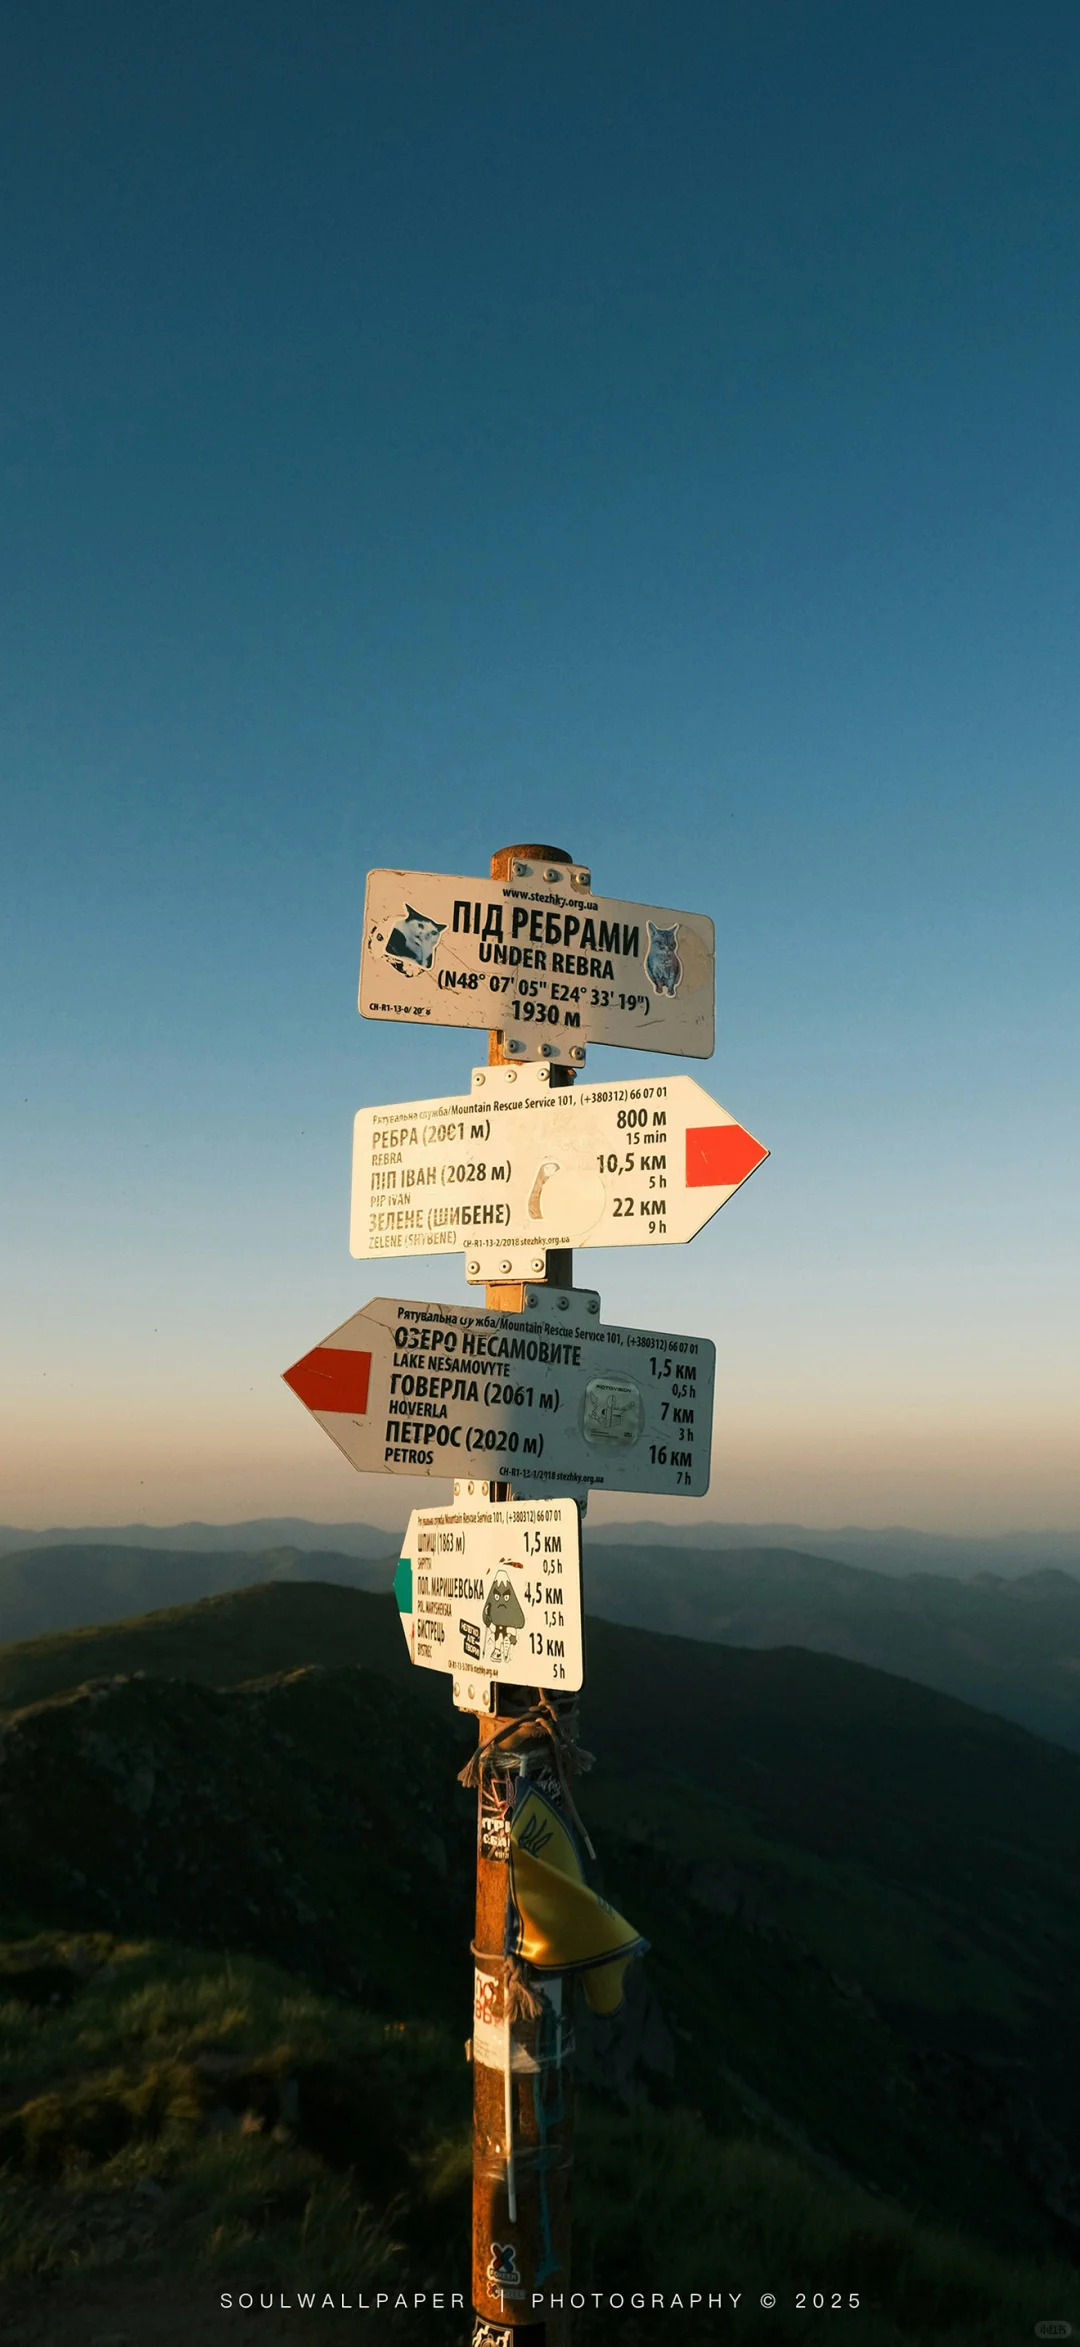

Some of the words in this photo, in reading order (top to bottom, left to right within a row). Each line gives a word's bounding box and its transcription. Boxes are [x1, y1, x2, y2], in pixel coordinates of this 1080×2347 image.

[502, 887, 598, 911] www.stezhky.org.ua
[452, 900, 504, 943] ПІД
[512, 907, 640, 958] РЕБРАМИ
[479, 942, 548, 971] UNDER
[551, 951, 615, 980] REBRA
[437, 969, 486, 991] (N48°
[551, 984, 587, 1004] E24°
[511, 1000, 560, 1026] 1930
[493, 1099, 523, 1112] Rescue
[525, 1096, 556, 1109] Service
[558, 1094, 577, 1107] 101,
[580, 1089, 628, 1106] (+380312)
[630, 1089, 641, 1100] 66
[643, 1087, 655, 1099] 07
[656, 1086, 667, 1098] 01
[616, 1108, 648, 1129] 800
[372, 1126, 419, 1150] РЕБРА
[470, 1119, 491, 1142] м)
[626, 1132, 640, 1145] 15
[643, 1130, 667, 1144] min
[371, 1152, 403, 1166] REBRA
[597, 1152, 635, 1175] 10,5
[640, 1155, 667, 1171] км
[371, 1170, 396, 1191] ПІП
[401, 1166, 437, 1188] ІВАН
[441, 1163, 487, 1187] (2028
[491, 1160, 512, 1184] м)
[649, 1175, 656, 1189] 5
[659, 1175, 667, 1188] h
[370, 1195, 386, 1208] PIP
[388, 1192, 411, 1205] IVAN
[612, 1197, 635, 1217] 22
[640, 1200, 667, 1216] км
[369, 1209, 424, 1233] ЗЕЛЕНЕ
[427, 1203, 511, 1230] (ШИБЕНЕ)
[649, 1220, 656, 1234] 9
[659, 1220, 667, 1233] h
[368, 1234, 402, 1249] ZELENE
[397, 1307, 458, 1326] Рятувальна
[545, 1323, 573, 1338] Rescue
[575, 1327, 605, 1342] Service
[607, 1332, 624, 1346] 101,
[627, 1334, 667, 1352] (+380312)
[668, 1342, 678, 1352] 66
[679, 1343, 689, 1353] 07
[689, 1344, 698, 1355] 01
[394, 1326, 457, 1353] ОЗЕРО
[462, 1333, 581, 1366] НЕСАМОВИТЕ
[393, 1352, 425, 1369] LAKE
[427, 1355, 510, 1377] NESAMOVYTE
[650, 1356, 672, 1379] 1,5
[675, 1364, 697, 1380] км
[390, 1373, 479, 1402] ГОВЕРЛА
[484, 1382, 534, 1407] (2061
[539, 1388, 560, 1412] м)
[672, 1383, 687, 1398] 0,5
[689, 1386, 696, 1398] h
[389, 1400, 448, 1419] HOVERLA
[661, 1402, 670, 1421] 7
[673, 1408, 694, 1424] км
[385, 1420, 462, 1448] ПЕТРОС
[465, 1426, 519, 1452] (2020
[523, 1433, 544, 1458] м)
[678, 1428, 685, 1441] 3
[687, 1428, 694, 1441] h
[384, 1447, 434, 1465] PETROS
[650, 1444, 667, 1465] 16
[670, 1450, 692, 1467] км
[556, 1473, 604, 1485] stezhky.org.ua
[676, 1472, 683, 1484] 7
[685, 1472, 691, 1485] h
[492, 1511, 505, 1524] 101,
[506, 1510, 536, 1525] (+380312)
[537, 1510, 545, 1521] 66
[545, 1510, 553, 1521] 07
[554, 1509, 562, 1521] 01
[437, 1532, 454, 1555] (1863
[524, 1531, 541, 1556] 1,5
[544, 1536, 562, 1552] км
[543, 1559, 556, 1576] 0,5
[557, 1561, 563, 1574] h
[431, 1577, 485, 1600] МАРИШЕВСЬКА
[524, 1582, 542, 1607] 4,5
[545, 1588, 563, 1605] км
[544, 1611, 557, 1627] 1,5
[558, 1612, 564, 1627] h
[529, 1632, 543, 1655] 13
[547, 1639, 565, 1657] км
[553, 1664, 559, 1678] 5
[559, 1665, 565, 1679] h
